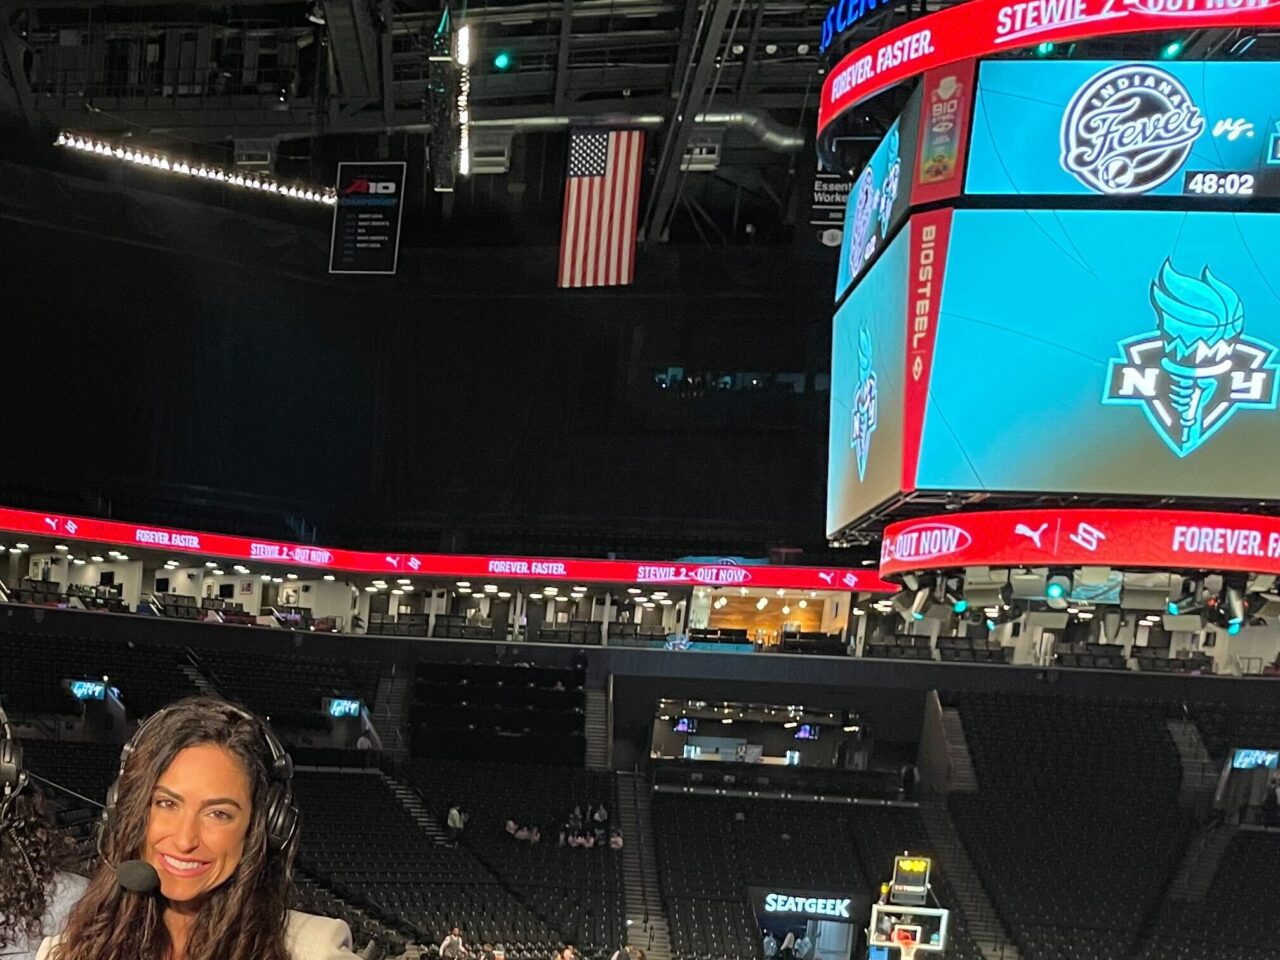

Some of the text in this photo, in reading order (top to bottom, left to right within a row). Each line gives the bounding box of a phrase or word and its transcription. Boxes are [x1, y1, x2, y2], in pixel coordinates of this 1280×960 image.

[996, 0, 1087, 34] STEWIE
[830, 29, 935, 104] FOREVER. FASTER.
[1091, 75, 1182, 107] INDIANA
[932, 100, 958, 116] BIO
[1072, 96, 1254, 169] Fever vs.
[1188, 173, 1254, 194] 48:02
[912, 225, 937, 349] BIOSTEEL
[896, 532, 920, 558] OUT
[920, 528, 961, 554] NOW
[1172, 525, 1264, 557] FOREVER.
[488, 560, 566, 575] FOREVER. FASTER.
[637, 565, 676, 580] STEWIE
[697, 567, 718, 581] OUT
[720, 568, 746, 582] NOW
[765, 894, 851, 918] SEATGEEK
